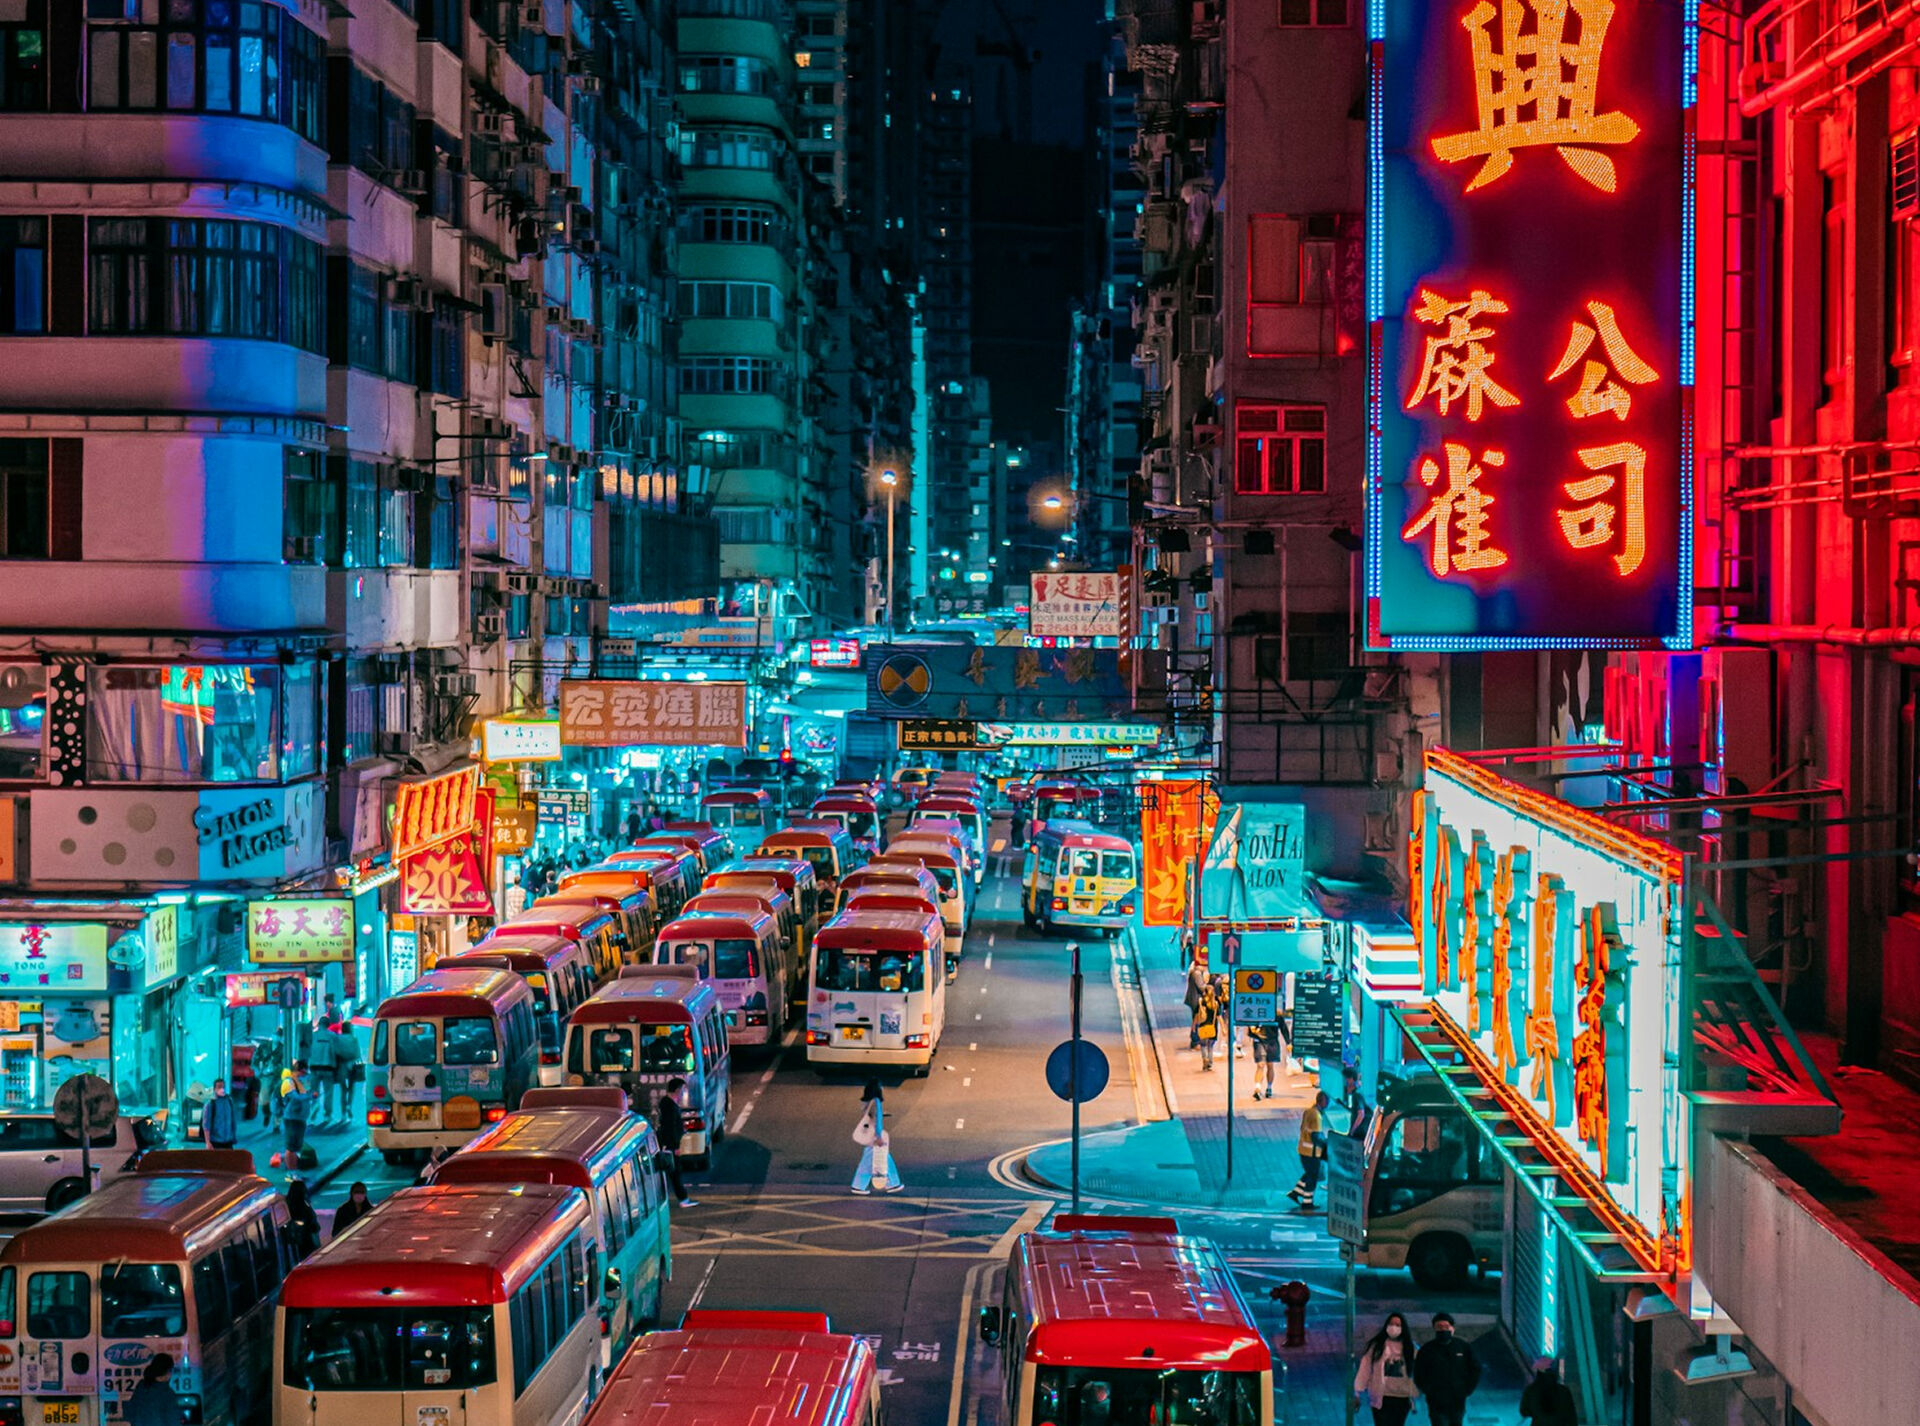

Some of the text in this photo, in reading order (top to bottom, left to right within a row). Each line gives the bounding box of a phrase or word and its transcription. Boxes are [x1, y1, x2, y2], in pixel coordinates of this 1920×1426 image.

[1432, 0, 1641, 193] 興
[1548, 300, 1660, 577] 公司
[192, 798, 275, 846] SALON
[221, 824, 295, 868] MORE
[416, 869, 458, 900] 20
[1245, 869, 1287, 888] ALON
[254, 906, 351, 938] 海天堂
[20, 923, 52, 960] 堂
[13, 961, 46, 971] TONG
[1240, 997, 1271, 1005] 24 hrs
